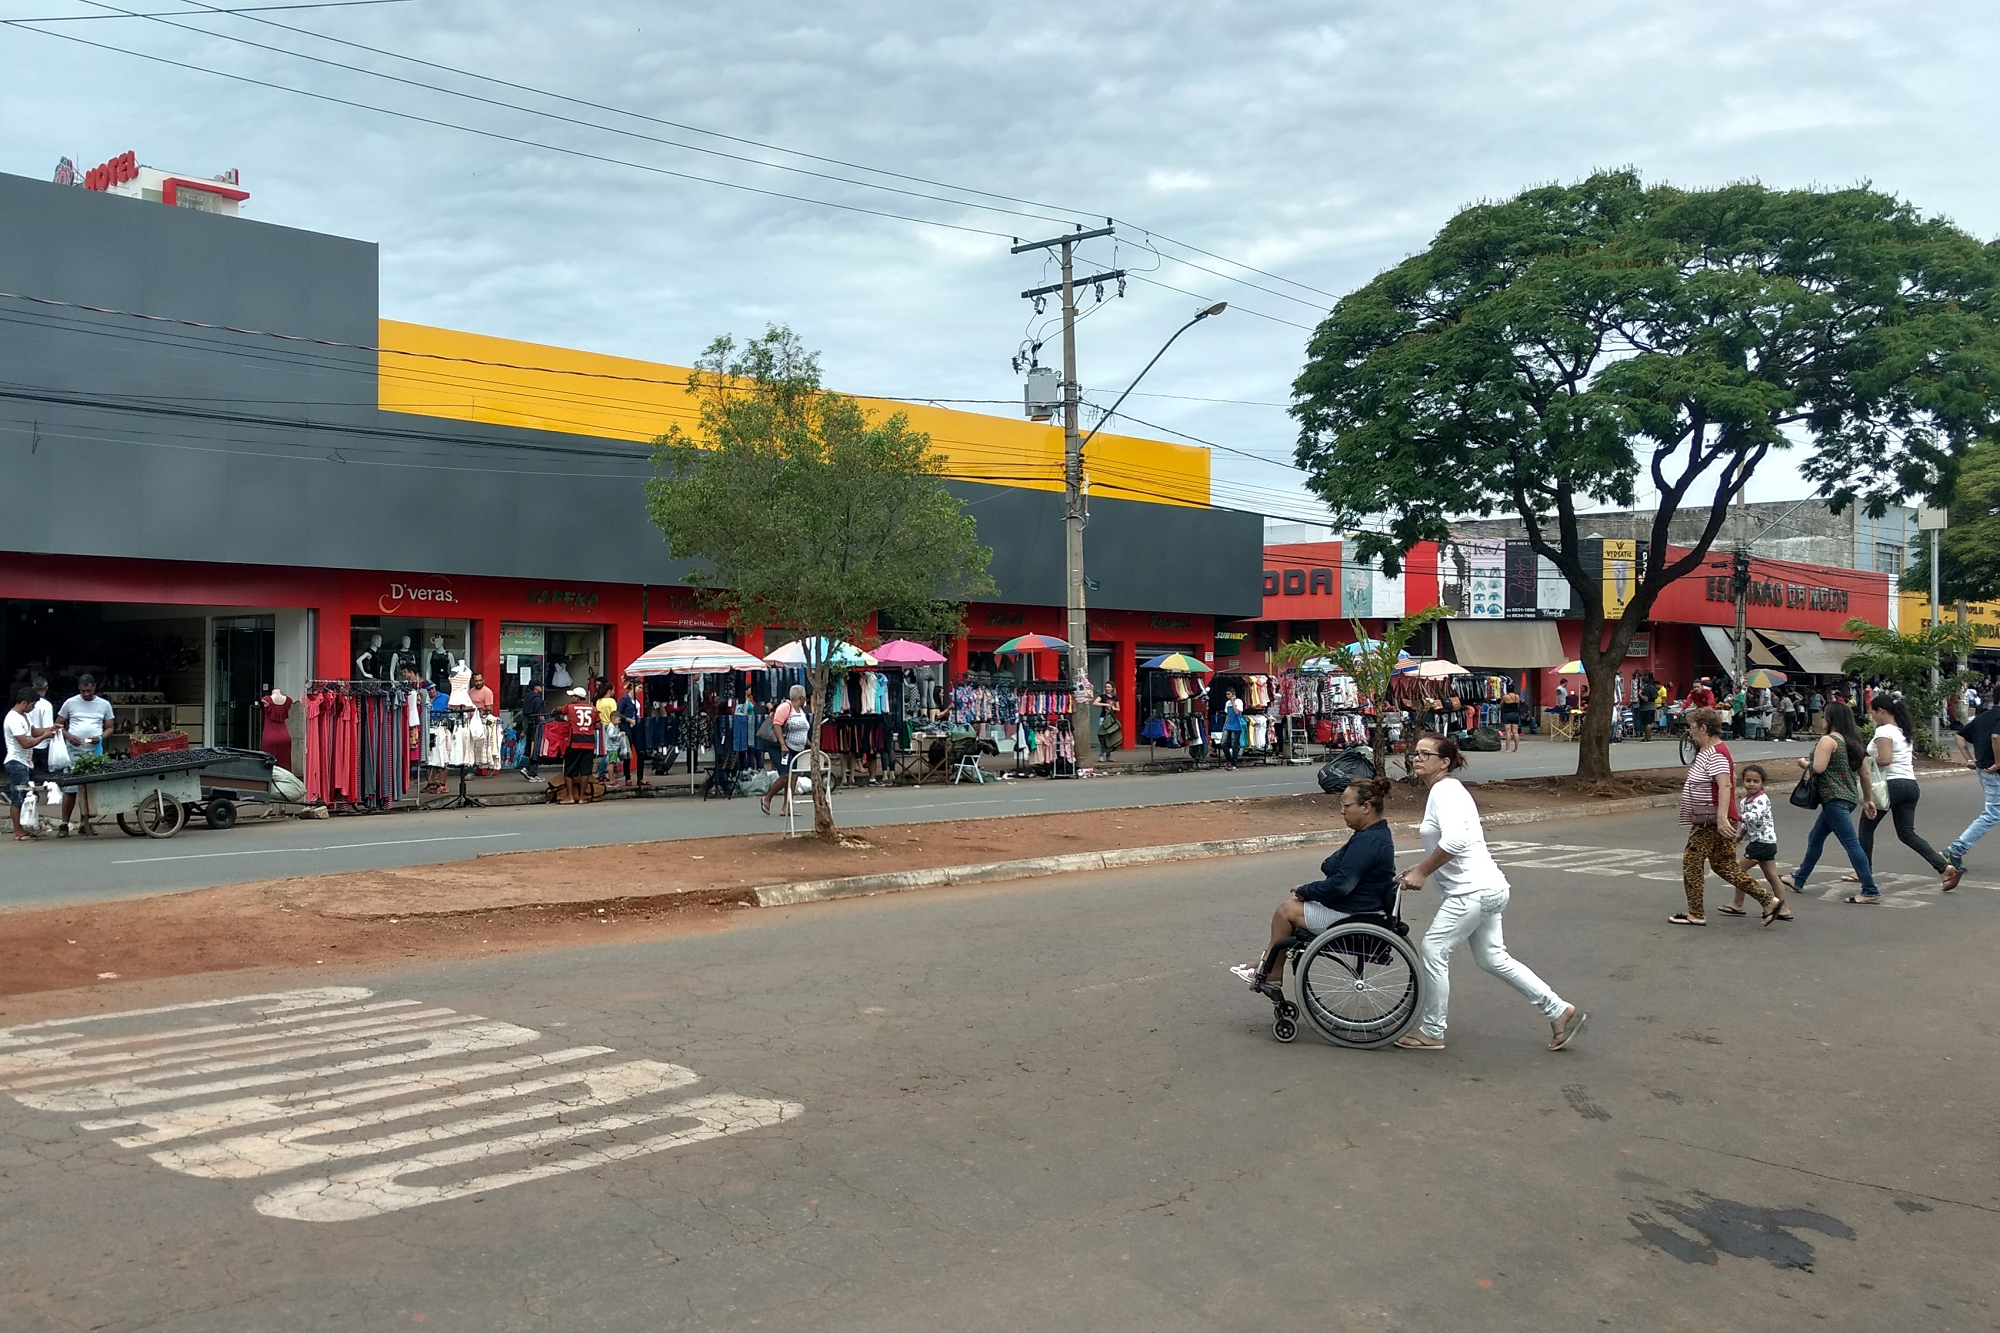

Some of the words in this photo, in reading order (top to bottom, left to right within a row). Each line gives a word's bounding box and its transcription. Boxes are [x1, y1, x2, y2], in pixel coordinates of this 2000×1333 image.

[84, 150, 139, 192] HOTEL
[524, 587, 600, 608] SAPEKA
[1786, 583, 1807, 609] DA
[1809, 586, 1849, 613] MODA
[678, 619, 714, 627] PREMIUM
[1215, 632, 1248, 640] SUBWAY
[576, 710, 592, 726] 35
